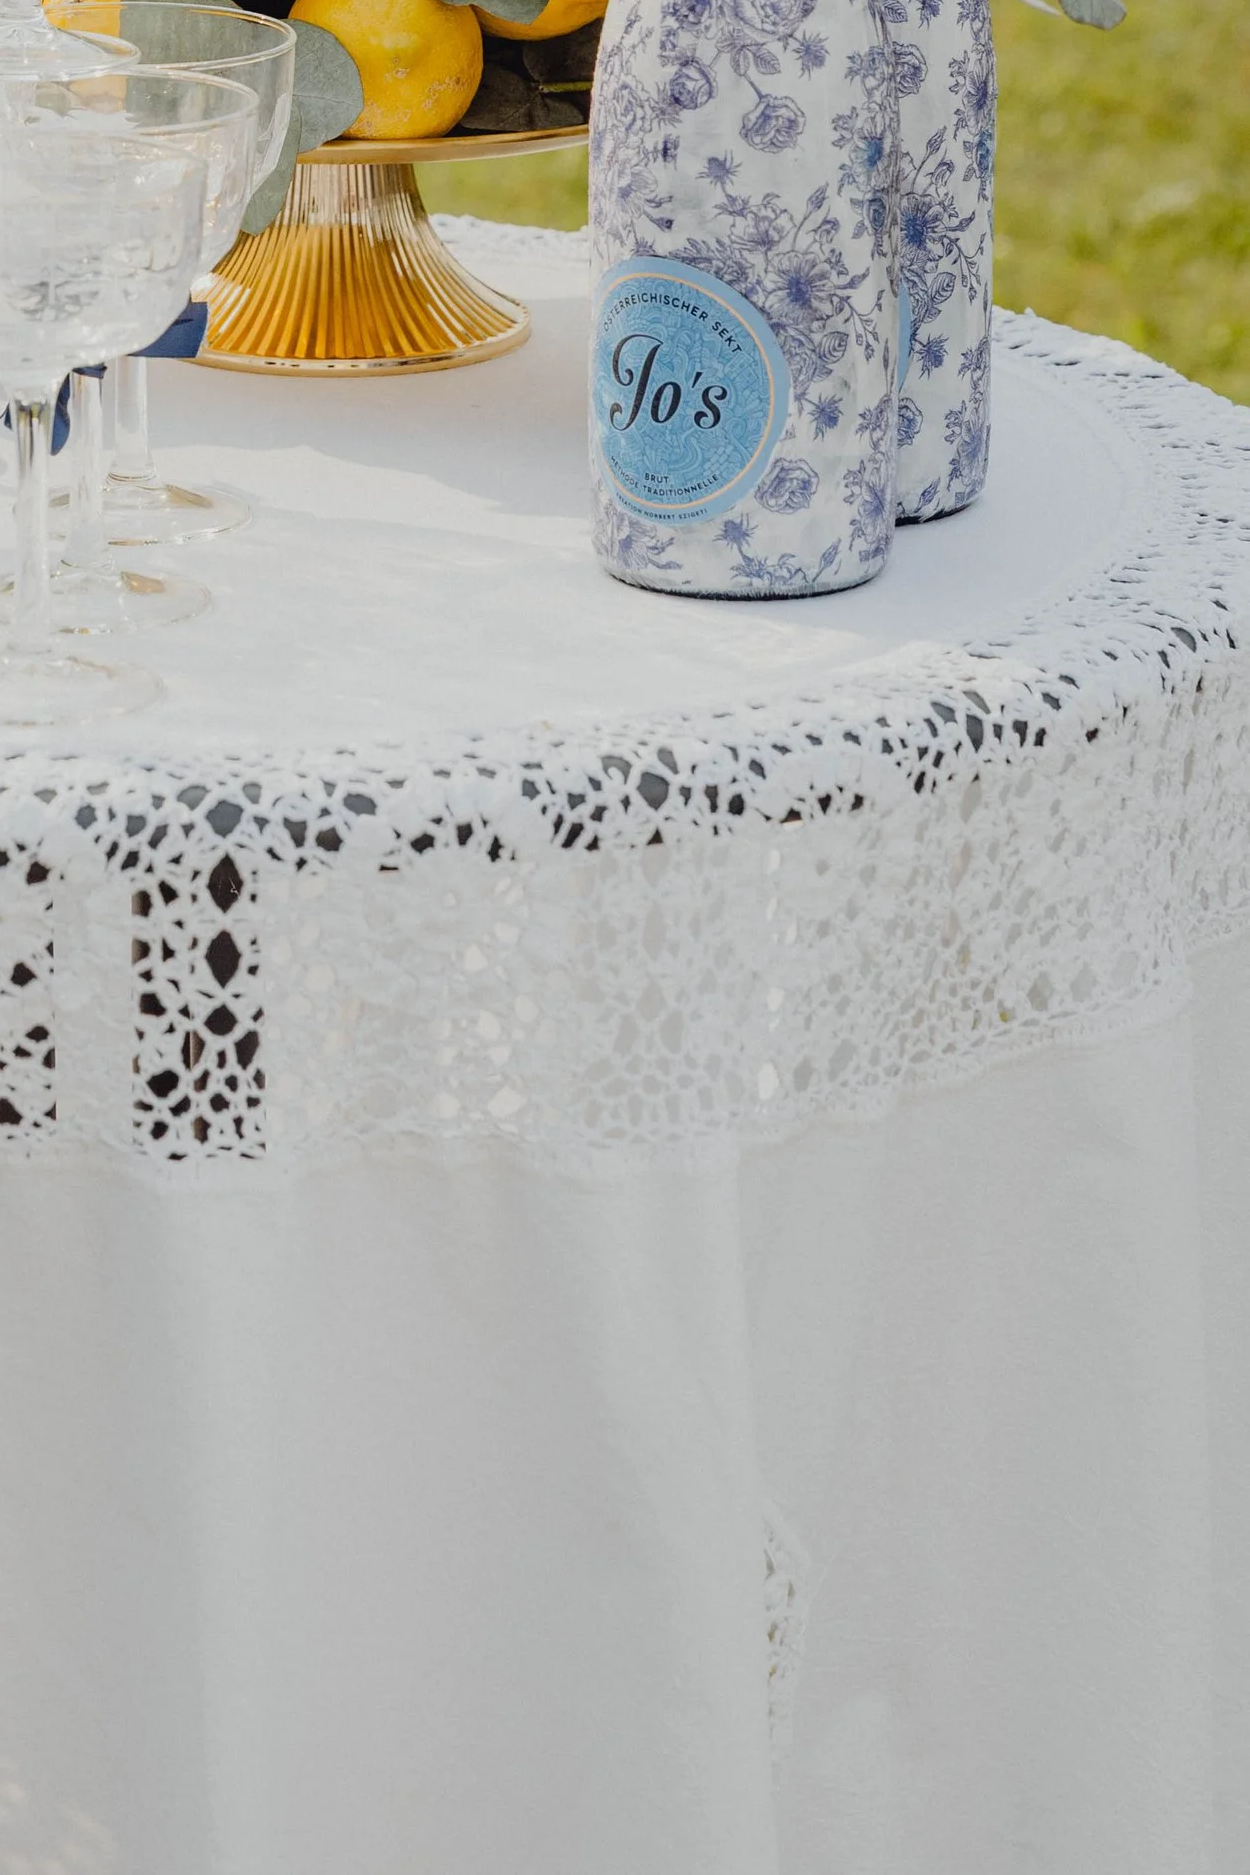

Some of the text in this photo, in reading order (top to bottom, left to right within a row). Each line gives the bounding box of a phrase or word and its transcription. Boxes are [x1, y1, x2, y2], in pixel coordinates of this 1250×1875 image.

[711, 321, 742, 353] SEKT
[609, 333, 728, 431] Jo's
[642, 473, 719, 496] TRADITIONNELLE
[644, 472, 669, 484] BRUT
[644, 510, 675, 520] NORBERT
[678, 508, 708, 519] SZIGETI
